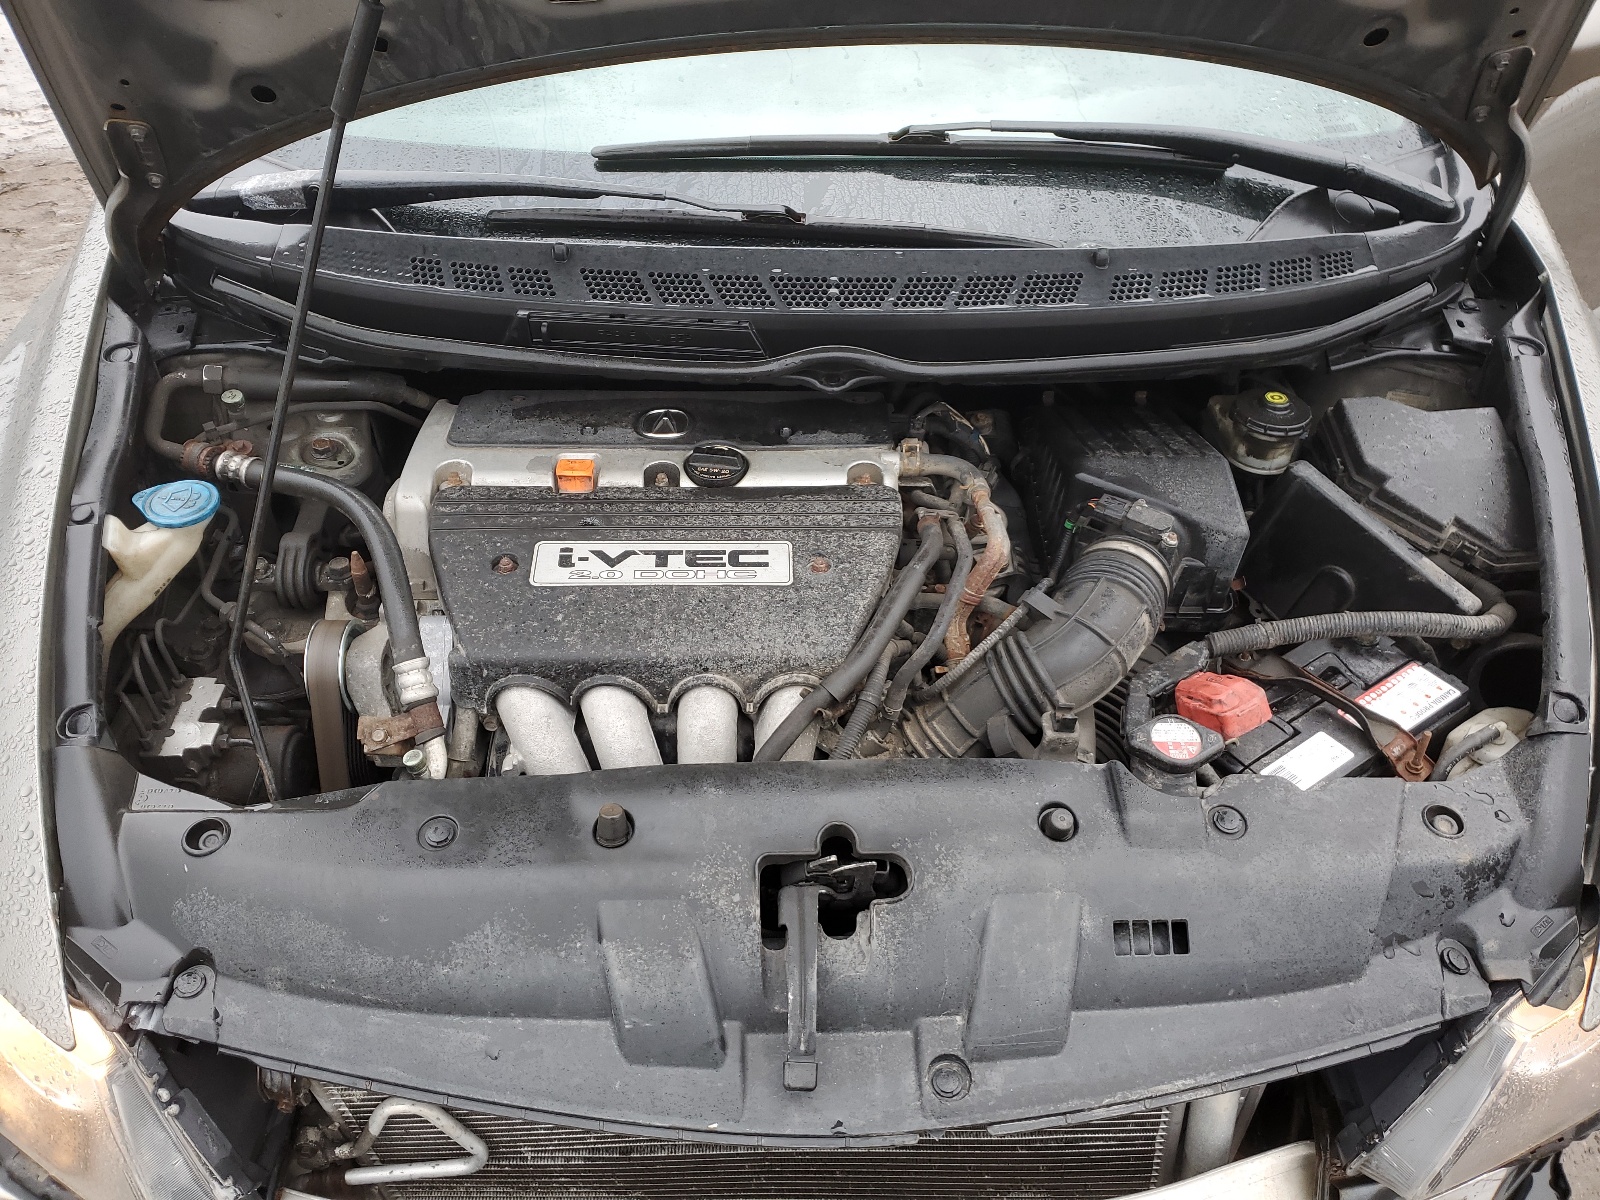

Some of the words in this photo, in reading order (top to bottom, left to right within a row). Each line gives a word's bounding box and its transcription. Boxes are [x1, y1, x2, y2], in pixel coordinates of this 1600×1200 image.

[558, 547, 770, 568] i-VTEC
[568, 569, 623, 580] 2.0
[633, 569, 757, 580] DOHC
